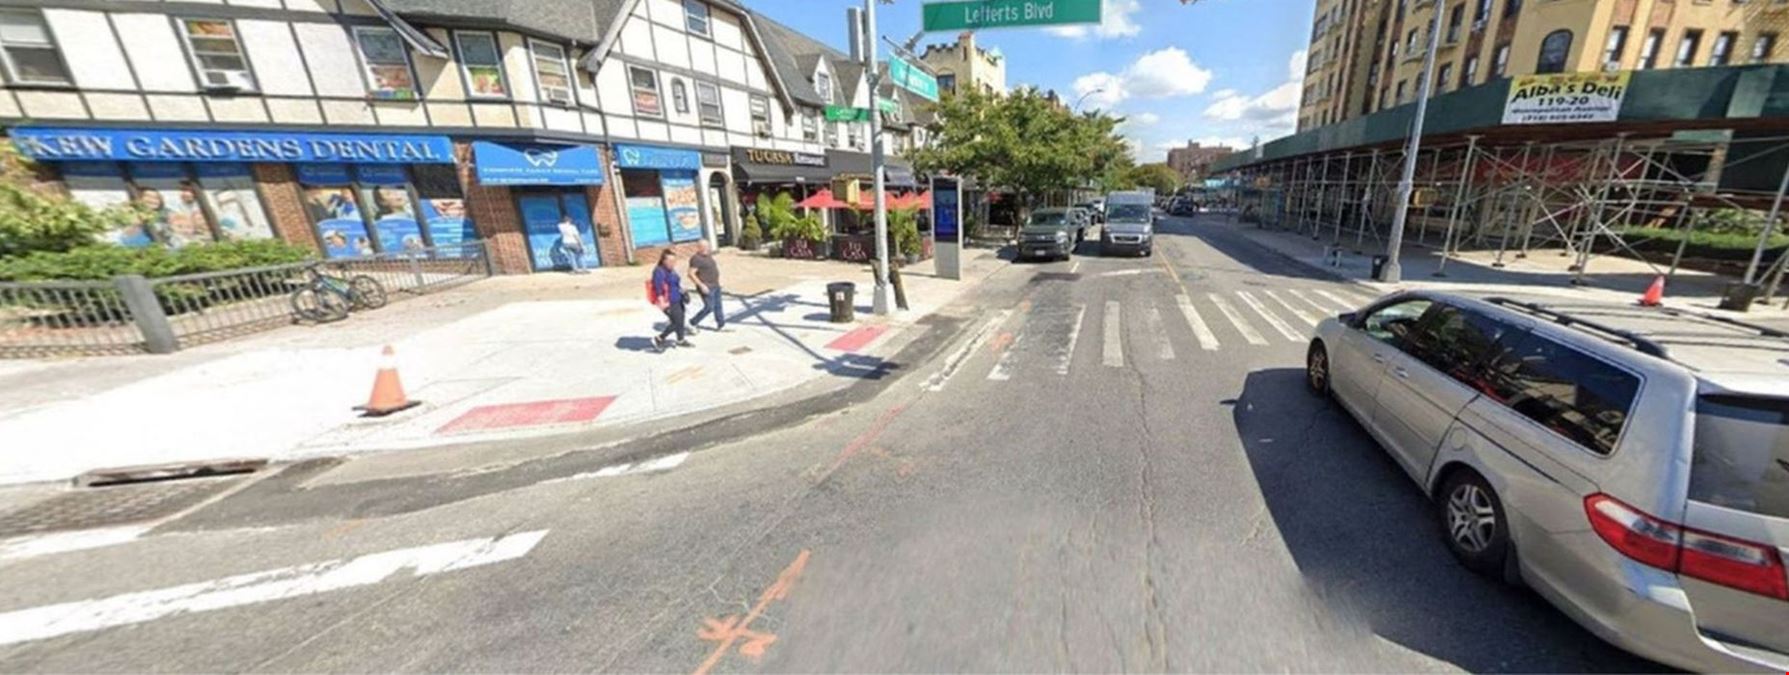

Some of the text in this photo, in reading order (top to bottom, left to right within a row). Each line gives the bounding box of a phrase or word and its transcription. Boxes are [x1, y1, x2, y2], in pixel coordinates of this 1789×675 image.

[964, 3, 1053, 23] Lefferts Blvd
[1511, 82, 1622, 103] Alba's Deli
[1538, 96, 1590, 106] 119-20
[25, 134, 441, 161] KEW GARDENS DENTAL
